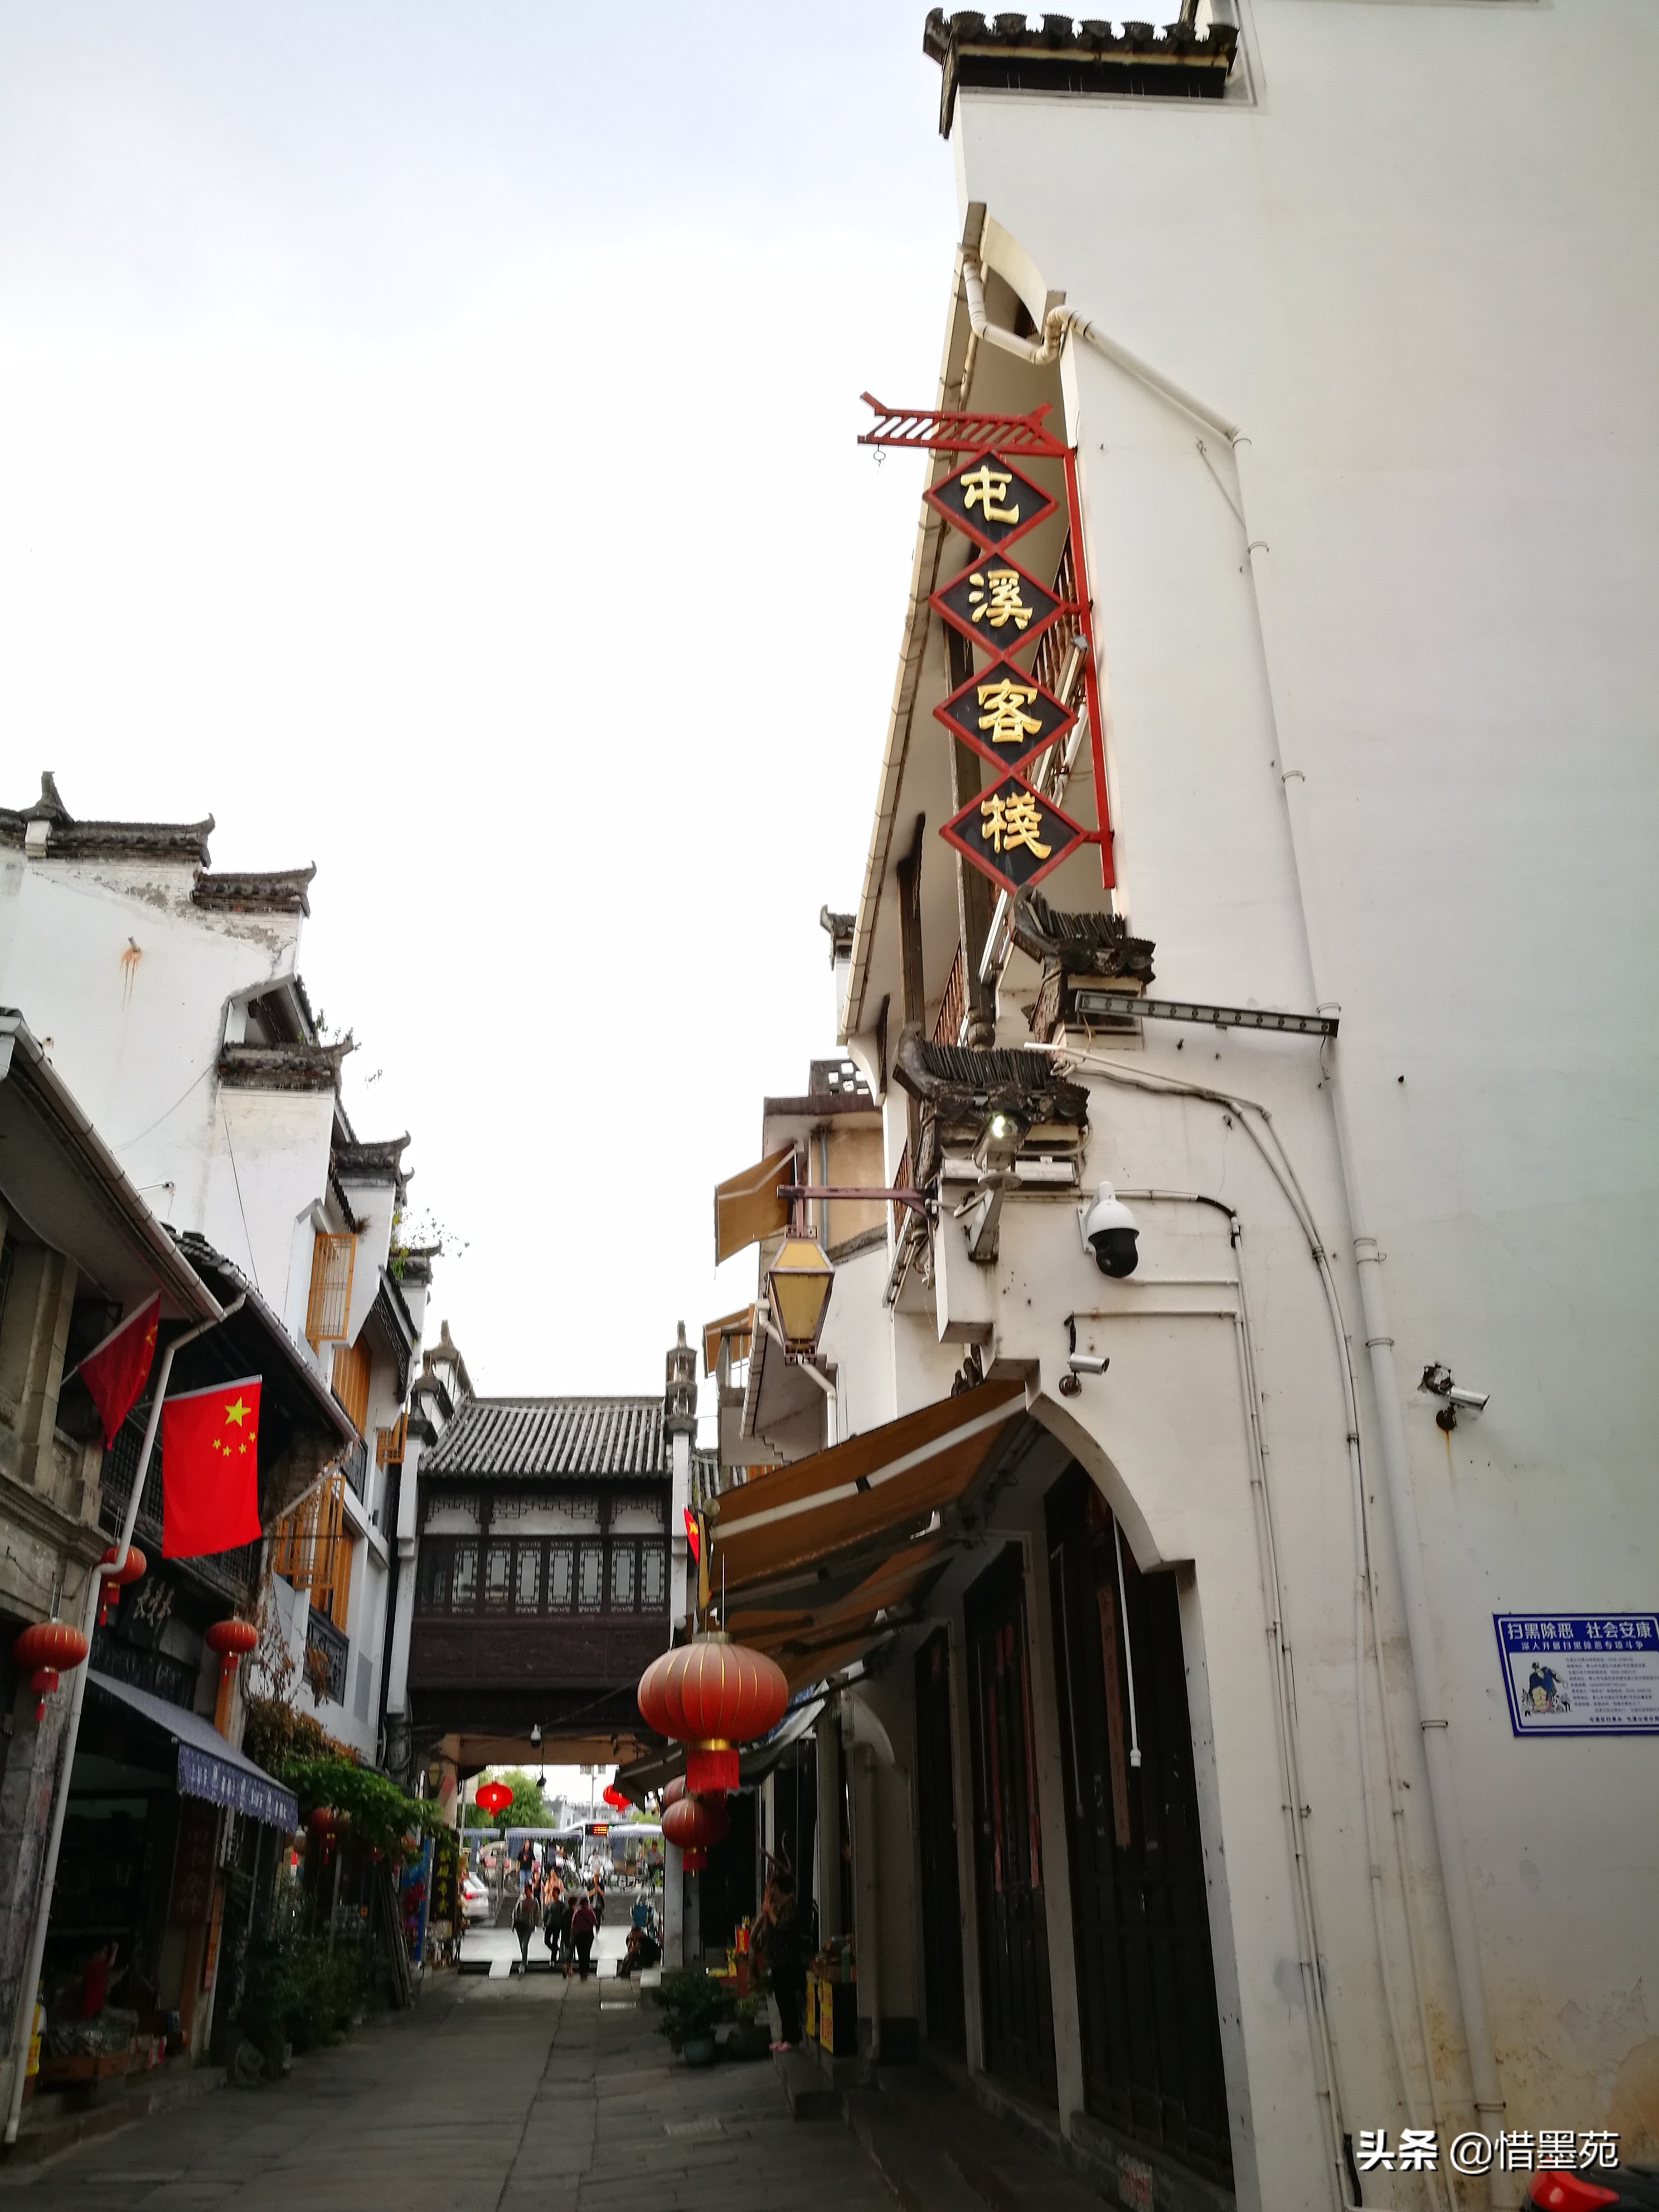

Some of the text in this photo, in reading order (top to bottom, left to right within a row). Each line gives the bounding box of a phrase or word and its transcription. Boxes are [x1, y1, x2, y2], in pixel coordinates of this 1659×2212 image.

[1507, 1621, 1652, 1640] 扫黑除恶 社会安康
[1521, 1641, 1643, 1651] 深入开展扫黑除恶专项斗争
